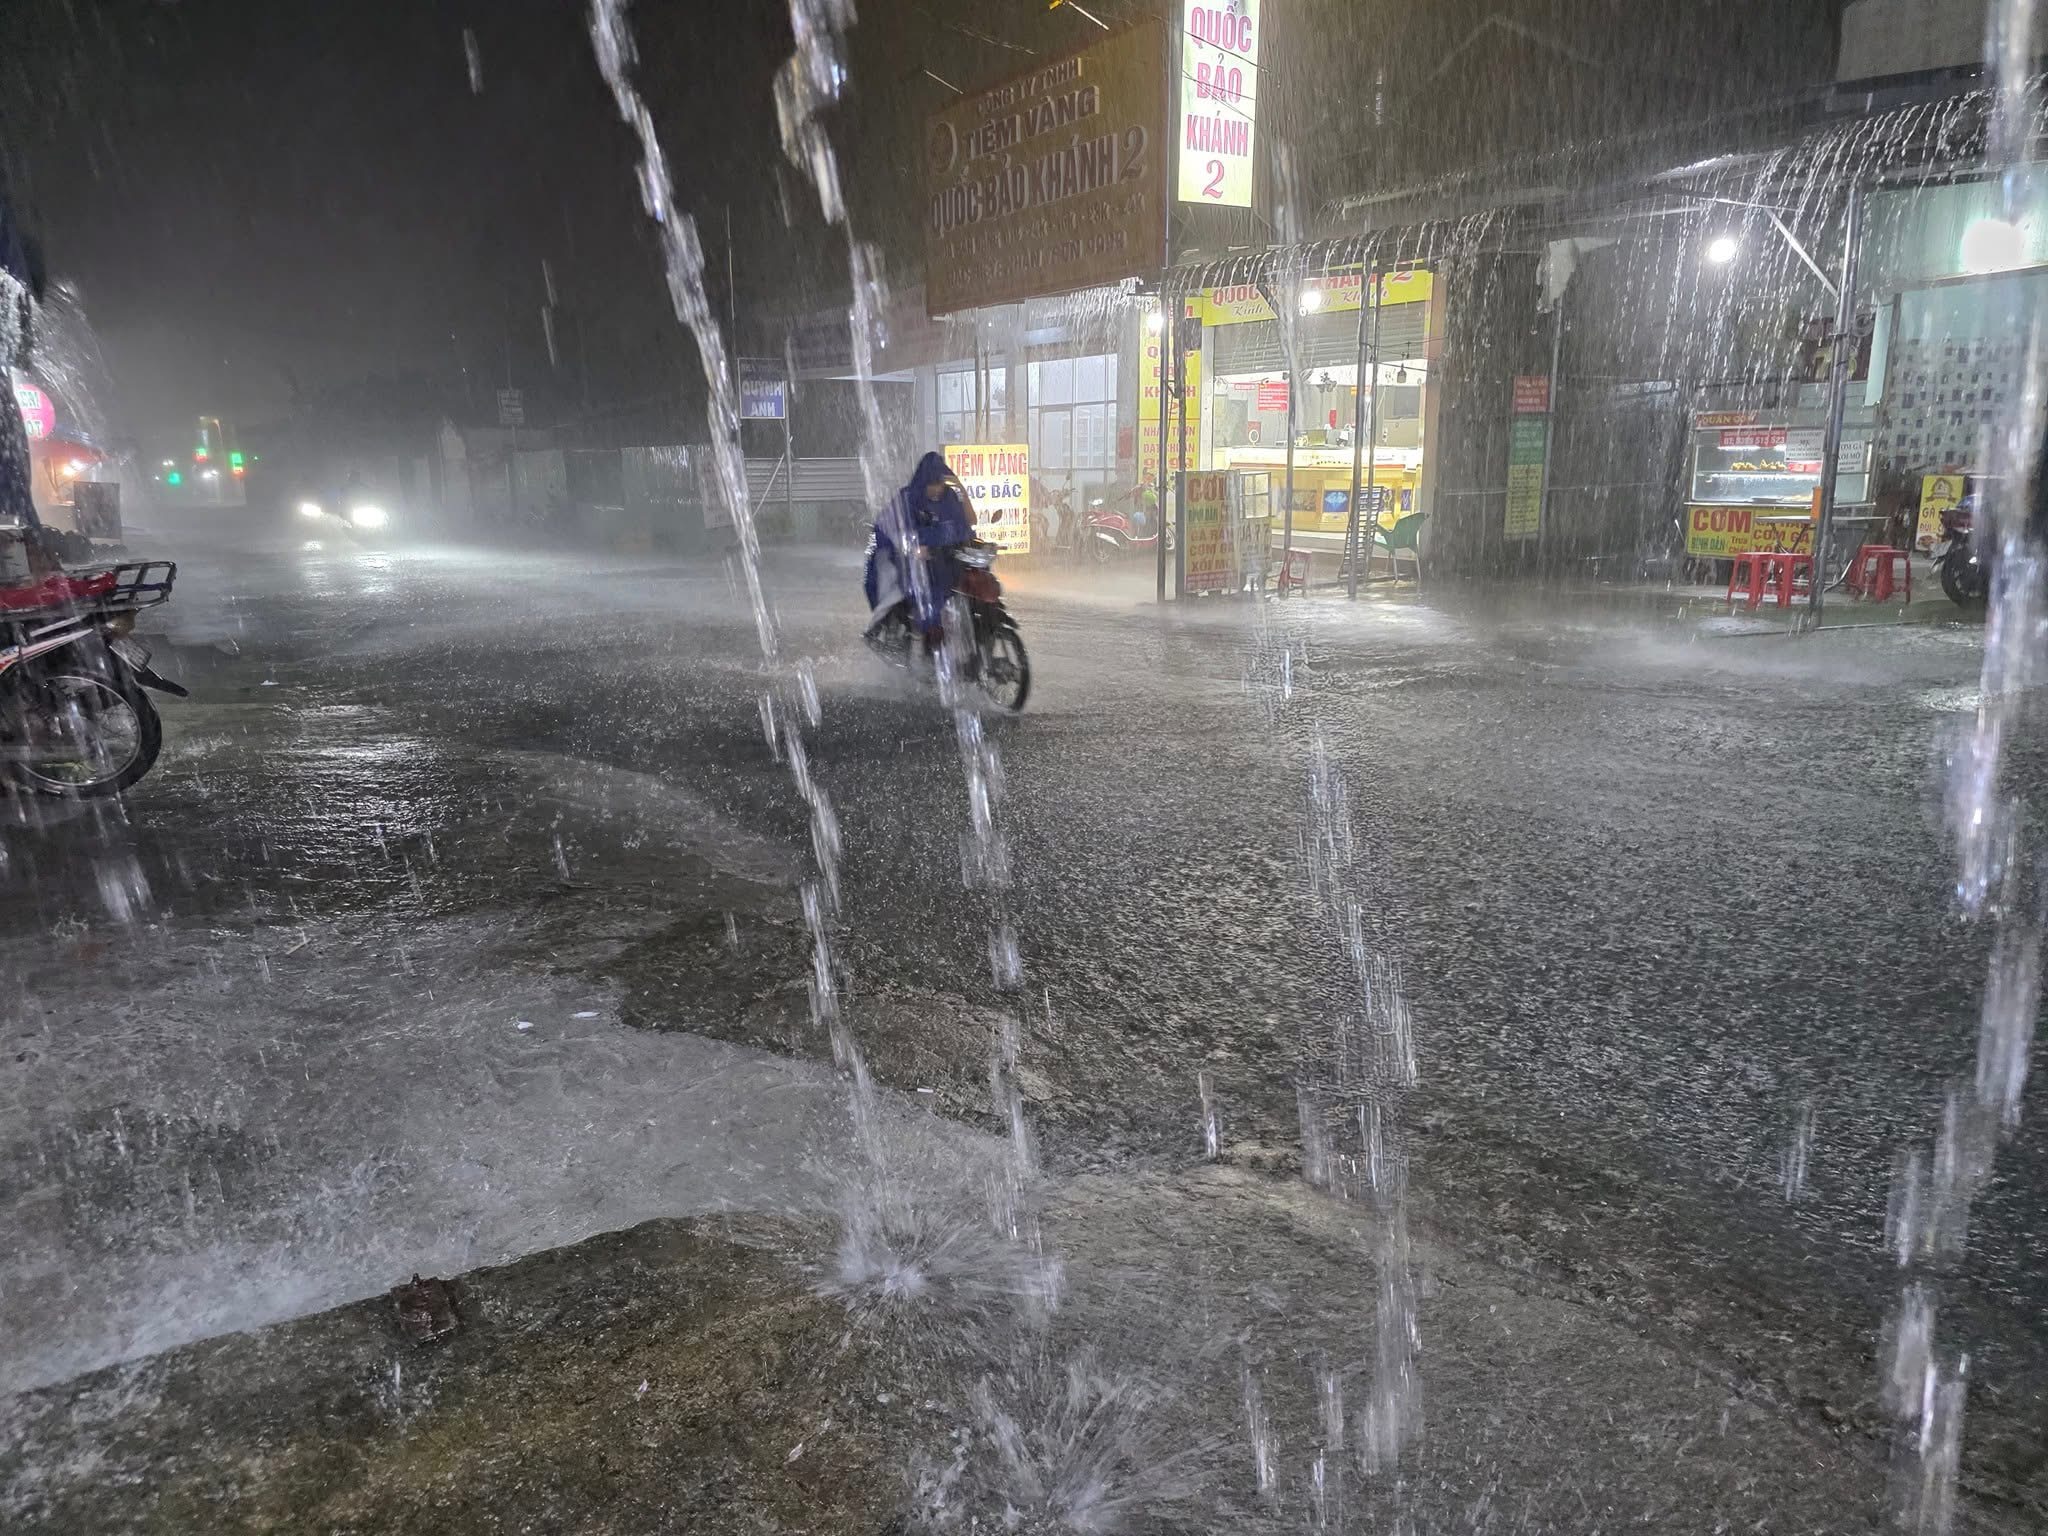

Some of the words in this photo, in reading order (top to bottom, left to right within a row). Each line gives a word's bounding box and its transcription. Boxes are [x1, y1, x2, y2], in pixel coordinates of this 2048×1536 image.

[1192, 0, 1252, 53] QUỐC
[1197, 52, 1242, 103] BẢO
[1024, 84, 1100, 138] VÀNG
[1187, 110, 1249, 157] KHÁNH
[984, 153, 1030, 219] BẢO
[1030, 134, 1118, 204] KHÁNH
[1120, 124, 1149, 183] 2
[1202, 159, 1225, 199] 2
[750, 401, 776, 417] ANH
[989, 448, 1028, 476] VÀNG
[991, 479, 1022, 498] BẮC
[1693, 507, 1752, 533] CƠM
